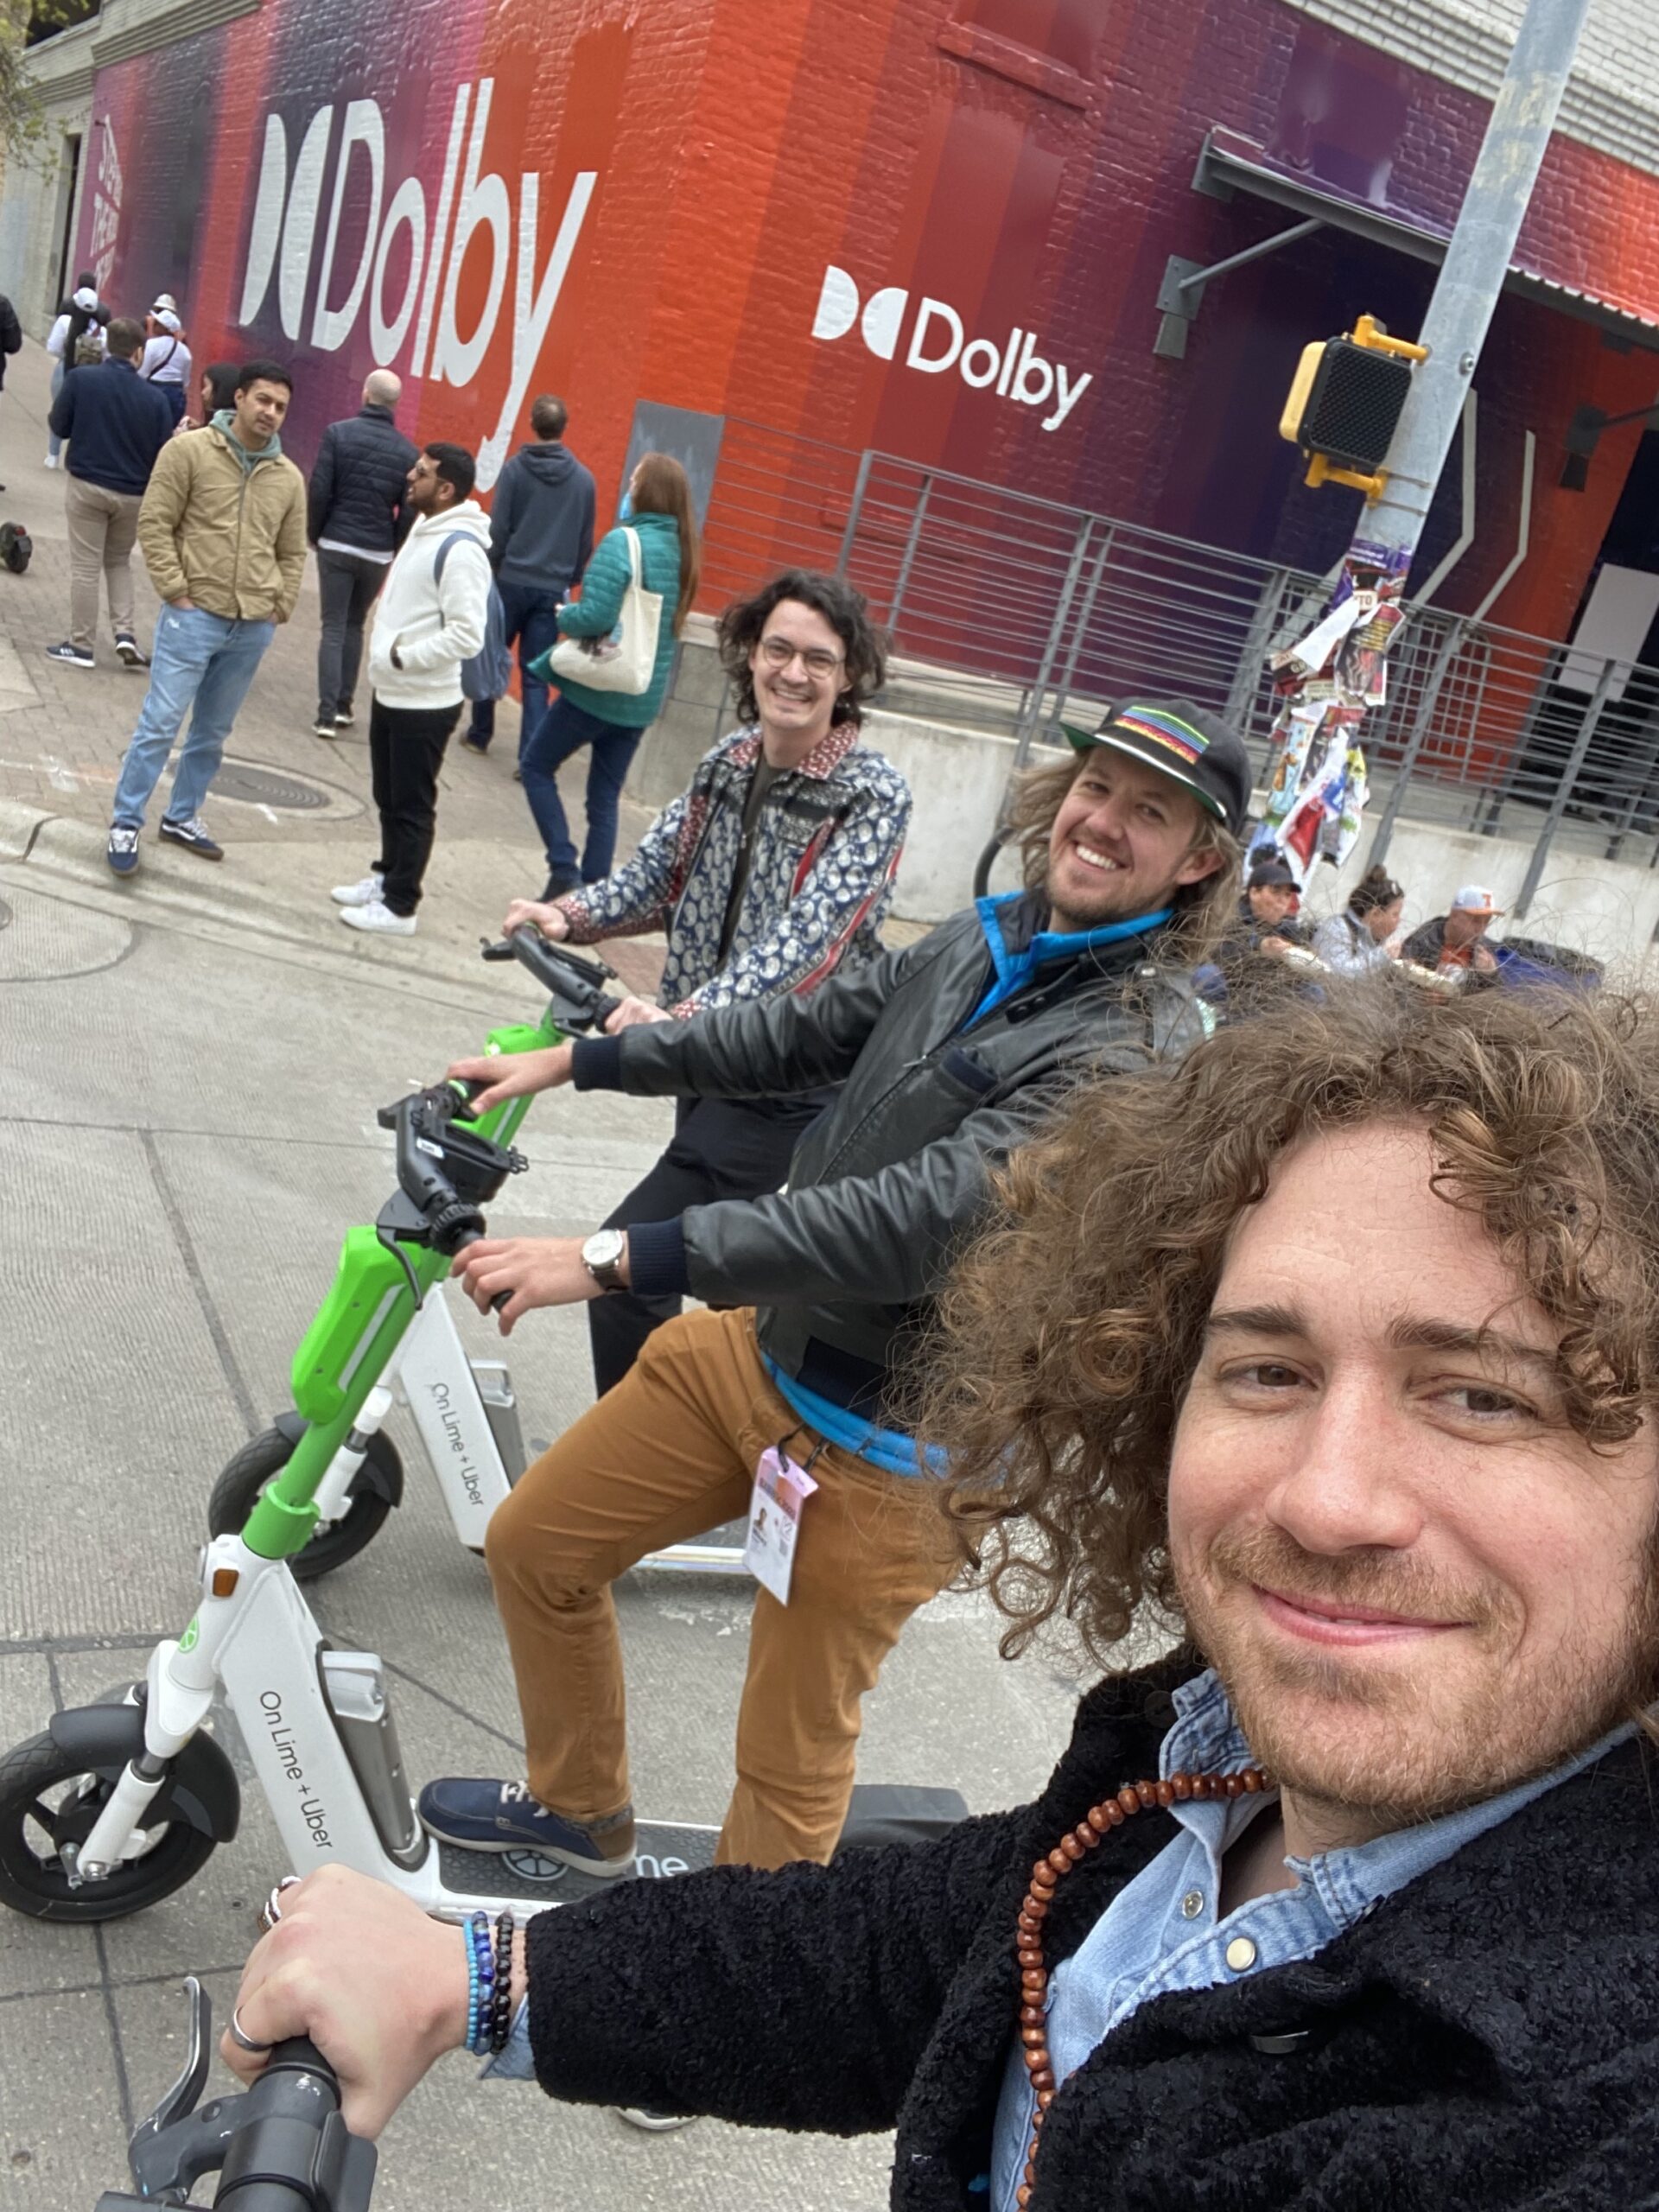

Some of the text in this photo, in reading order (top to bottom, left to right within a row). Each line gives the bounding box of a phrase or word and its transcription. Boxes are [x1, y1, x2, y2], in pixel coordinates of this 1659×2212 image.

[310, 77, 598, 493] Dolby
[906, 296, 1094, 432] Dolby
[431, 1382, 484, 1505] On Lime + Uber
[259, 1690, 333, 1848] On Lime + Uber
